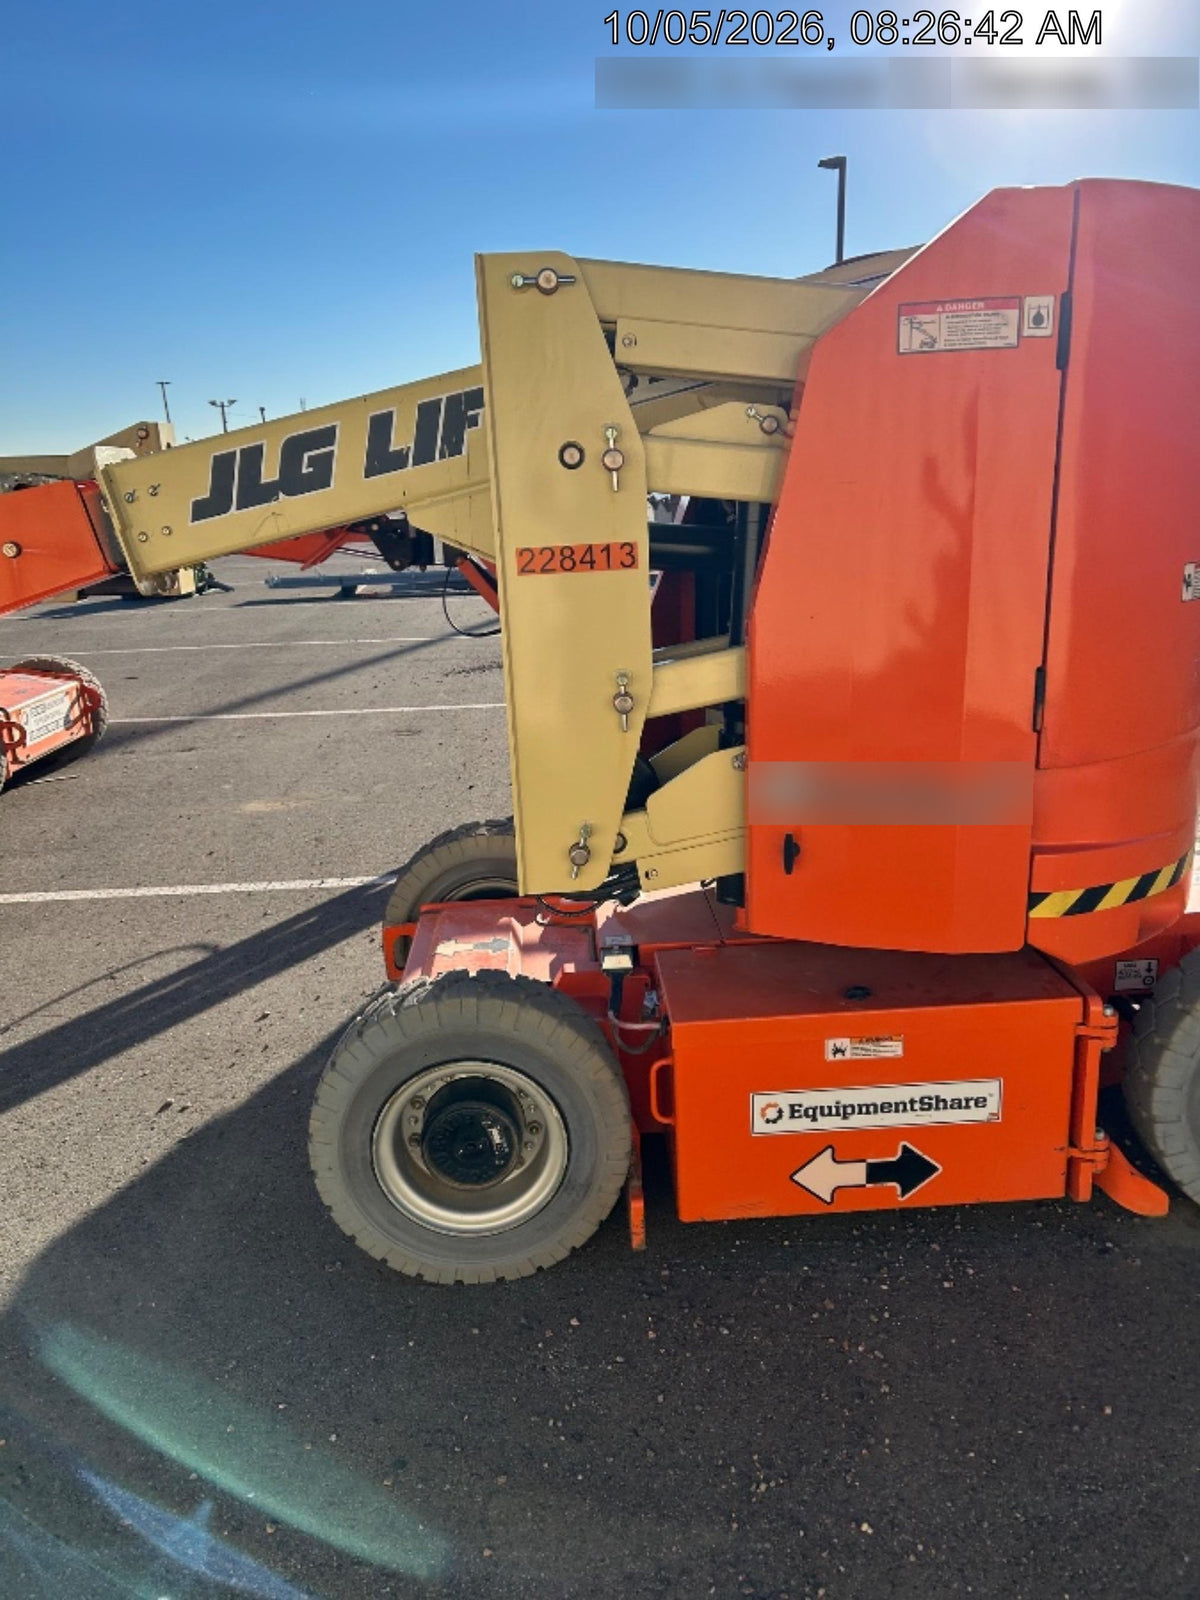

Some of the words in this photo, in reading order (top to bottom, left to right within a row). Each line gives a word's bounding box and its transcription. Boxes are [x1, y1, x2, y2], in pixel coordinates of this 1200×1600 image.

[945, 302, 985, 311] DANGER
[190, 423, 340, 524] JLG
[519, 541, 636, 573] 228413
[788, 1095, 987, 1122] EquipmentShare
